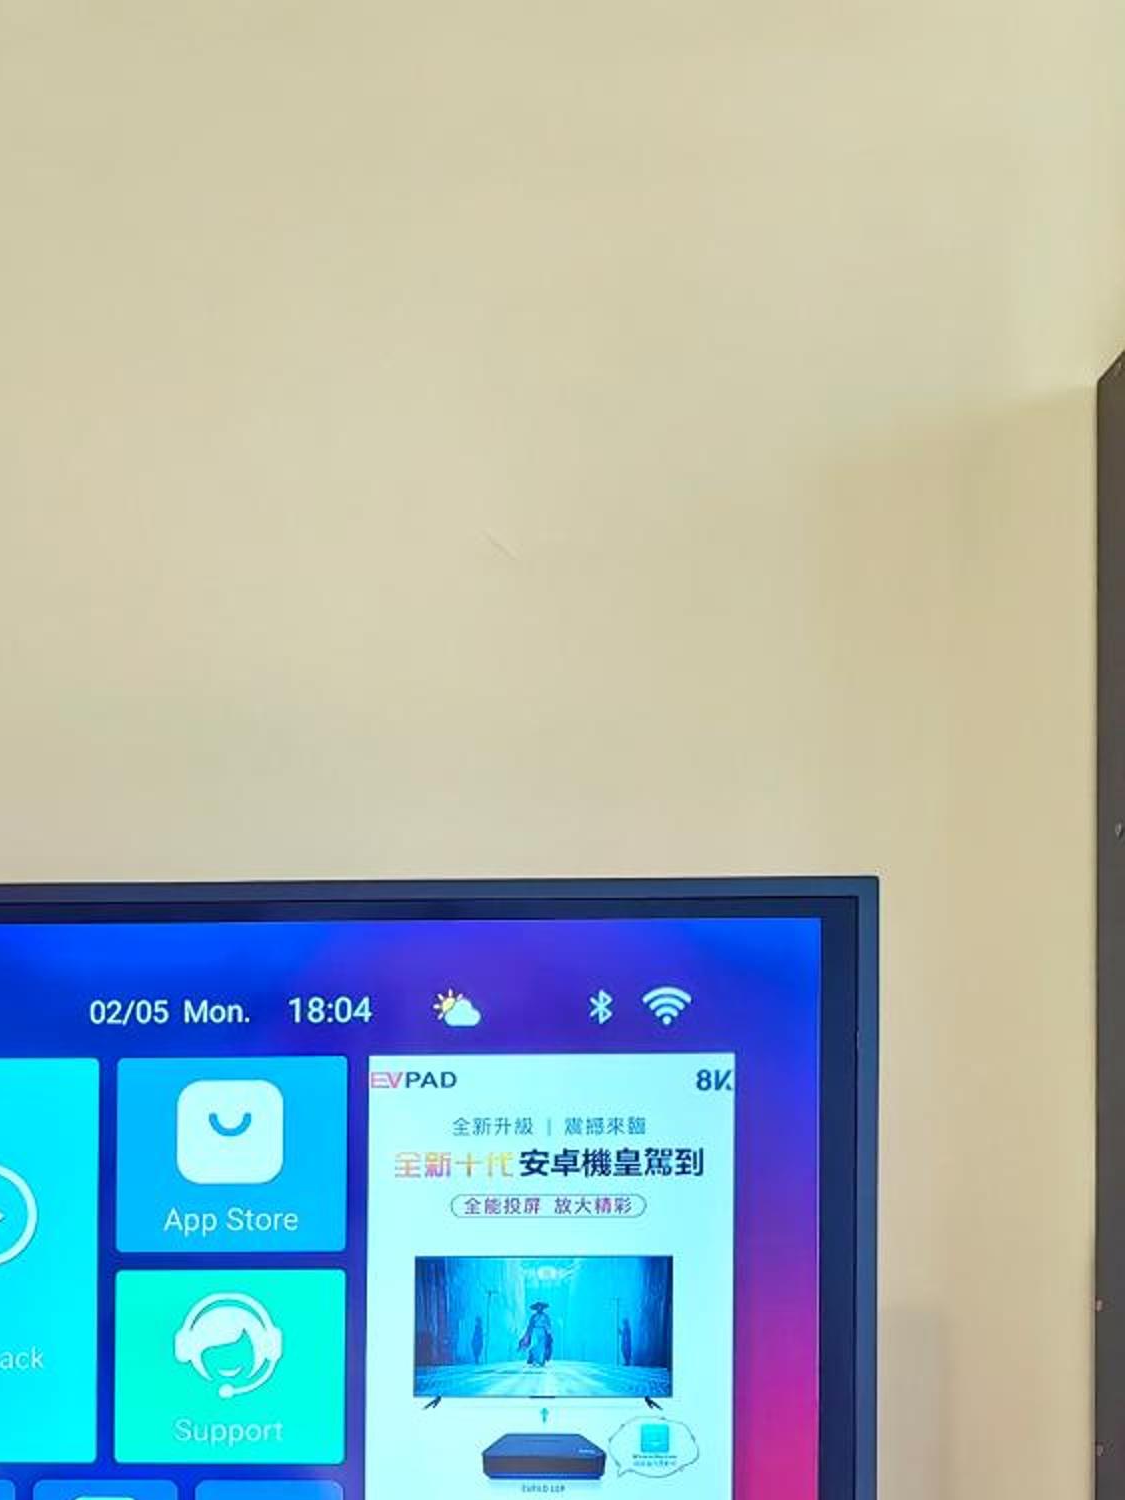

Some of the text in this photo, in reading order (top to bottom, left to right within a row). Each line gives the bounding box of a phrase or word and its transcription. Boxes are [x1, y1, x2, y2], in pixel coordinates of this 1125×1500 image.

[89, 997, 373, 1026] 02/05 Mon. 18:04
[370, 1071, 458, 1089] EVPAD
[695, 1069, 733, 1091] 8K
[163, 1206, 300, 1238] App Store
[174, 1418, 284, 1448] Support
